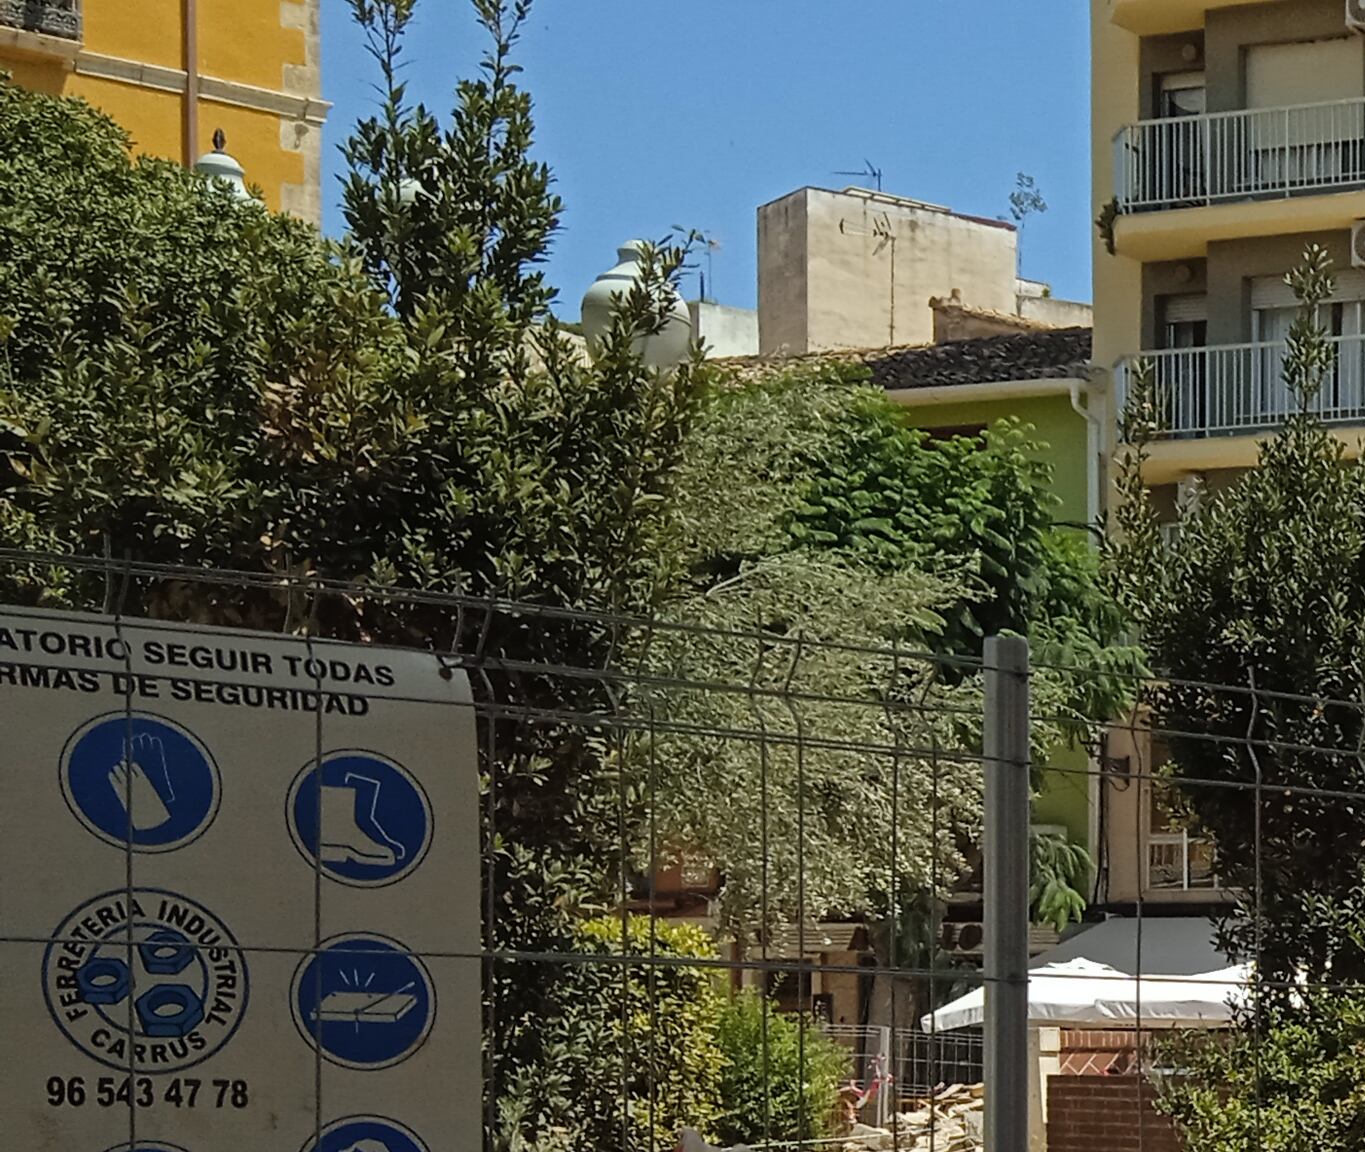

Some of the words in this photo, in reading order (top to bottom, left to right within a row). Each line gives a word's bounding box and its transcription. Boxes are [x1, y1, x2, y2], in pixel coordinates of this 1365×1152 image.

[143, 641, 272, 676] SEGUIR
[283, 655, 395, 687] TODAS
[113, 675, 159, 699] DE
[171, 679, 370, 717] SEGURIDAD
[56, 899, 146, 1022] FERRETERIA
[157, 899, 238, 1026] INDUSTRIAL
[90, 1028, 207, 1064] CARRUS
[46, 1077, 86, 1107] 96
[96, 1078, 154, 1108] 543
[164, 1079, 202, 1108] 47
[213, 1080, 249, 1109] 78
